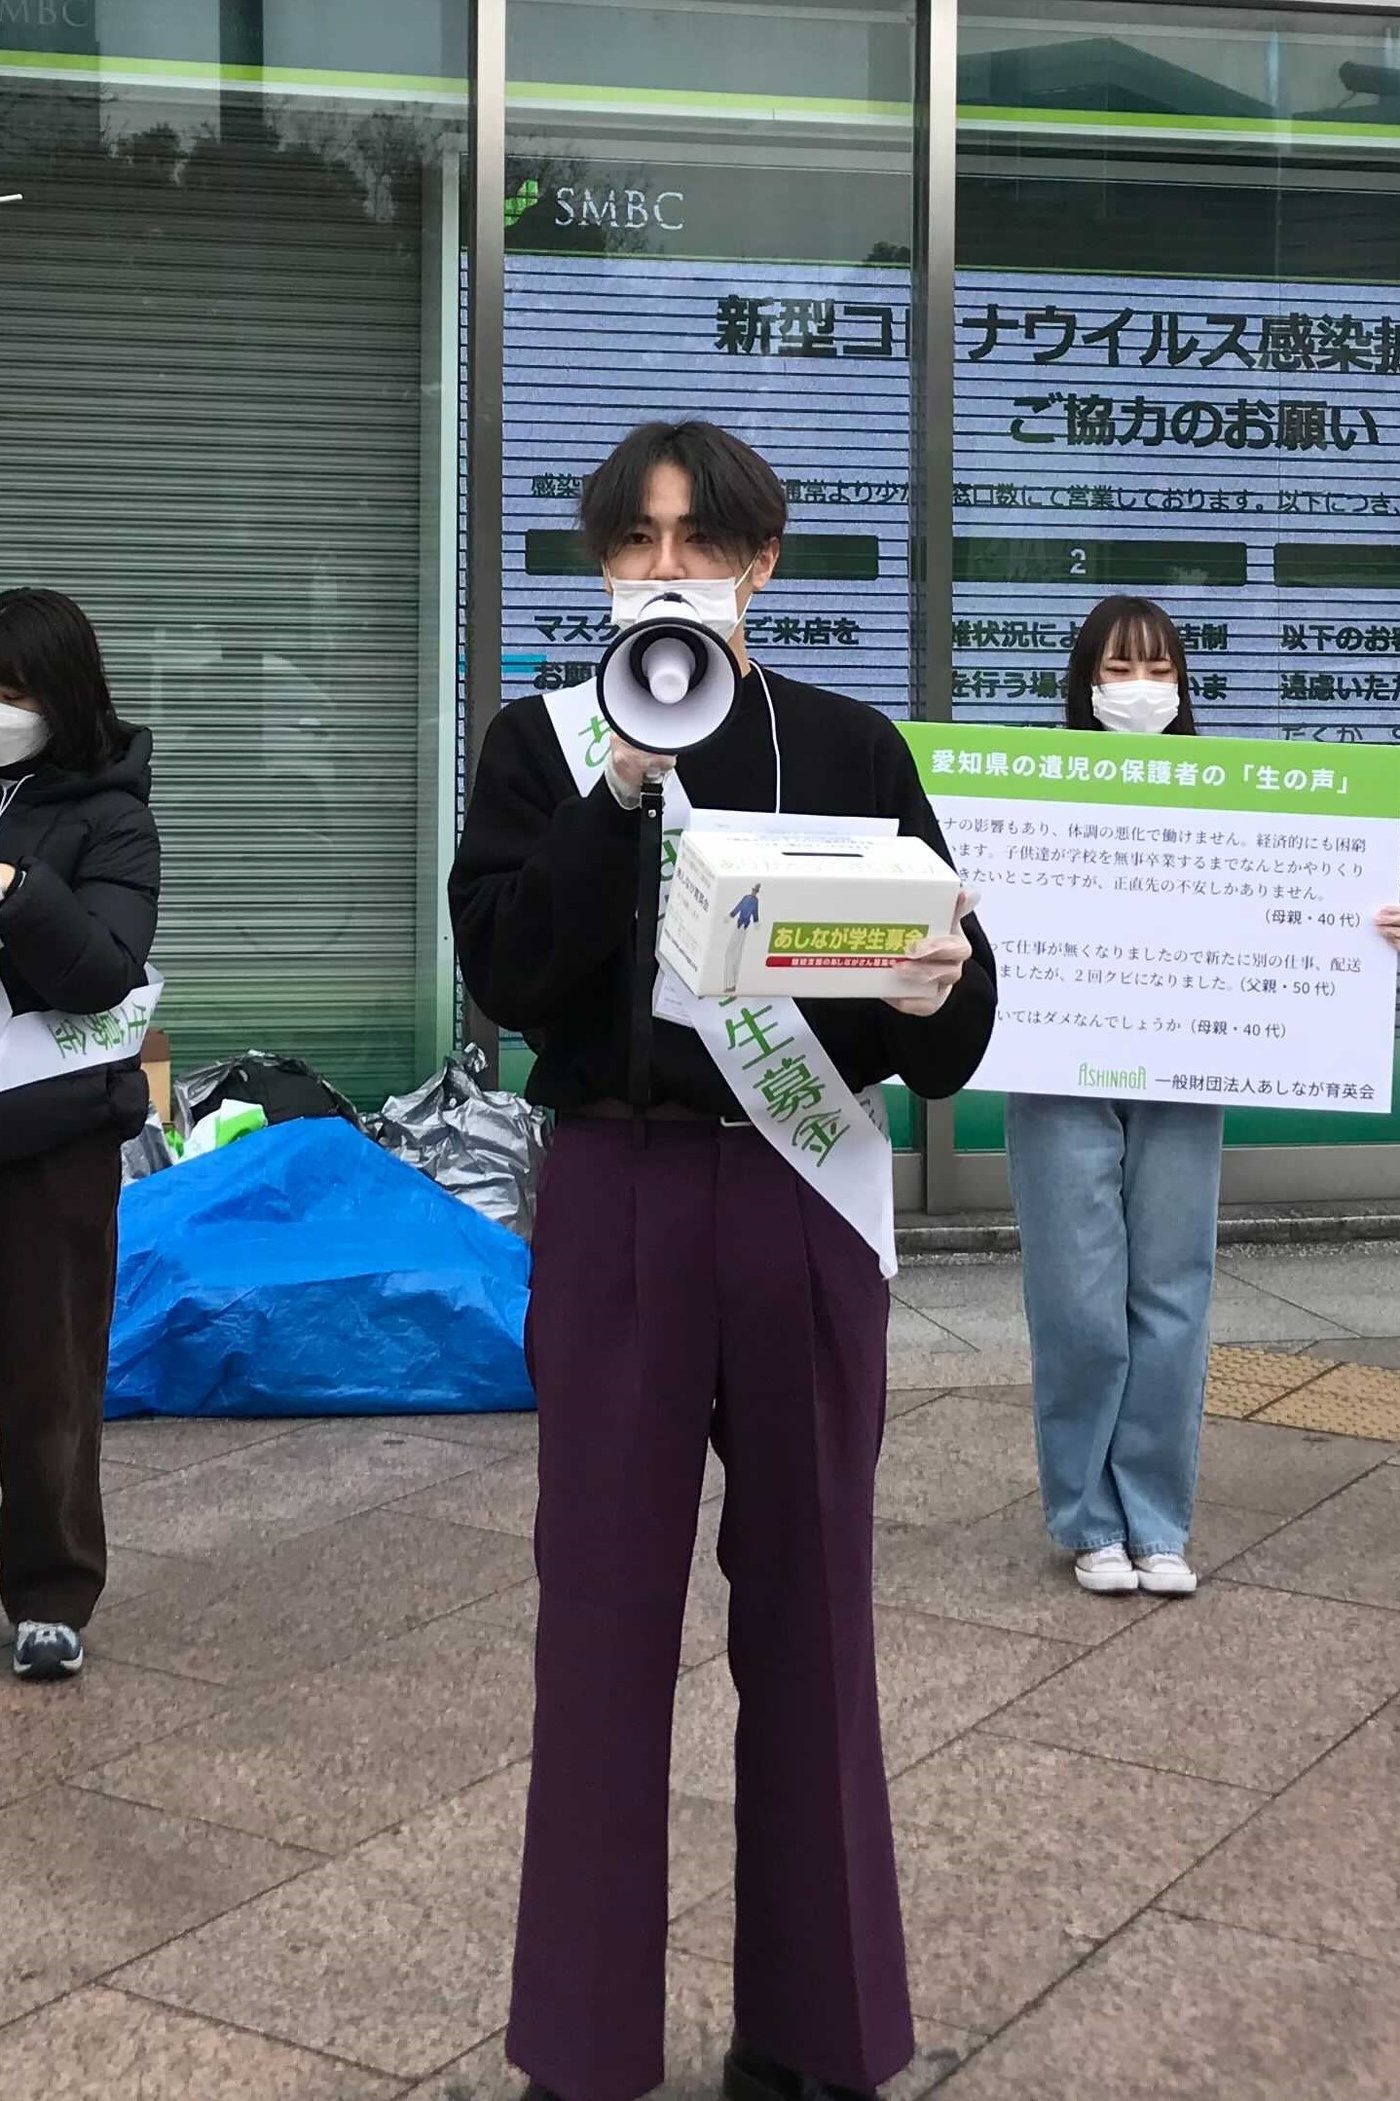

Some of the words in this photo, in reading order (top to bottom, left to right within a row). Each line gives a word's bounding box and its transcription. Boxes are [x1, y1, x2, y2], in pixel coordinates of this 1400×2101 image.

[555, 186, 685, 231] SMBC
[1010, 390, 1379, 451] ご協力のお願い
[1068, 548, 1088, 576] 2
[534, 614, 619, 642] マスク
[744, 616, 860, 645] ご来店を
[932, 749, 1348, 794] 愛知県の遺児の保護者の「生の声」
[937, 817, 1366, 853] ナの影響もあり、体調の悪化で働けません。経済的にも困窮
[718, 996, 850, 1167] 生募金
[1155, 1073, 1375, 1100] 一般財団法人あしなが育英会
